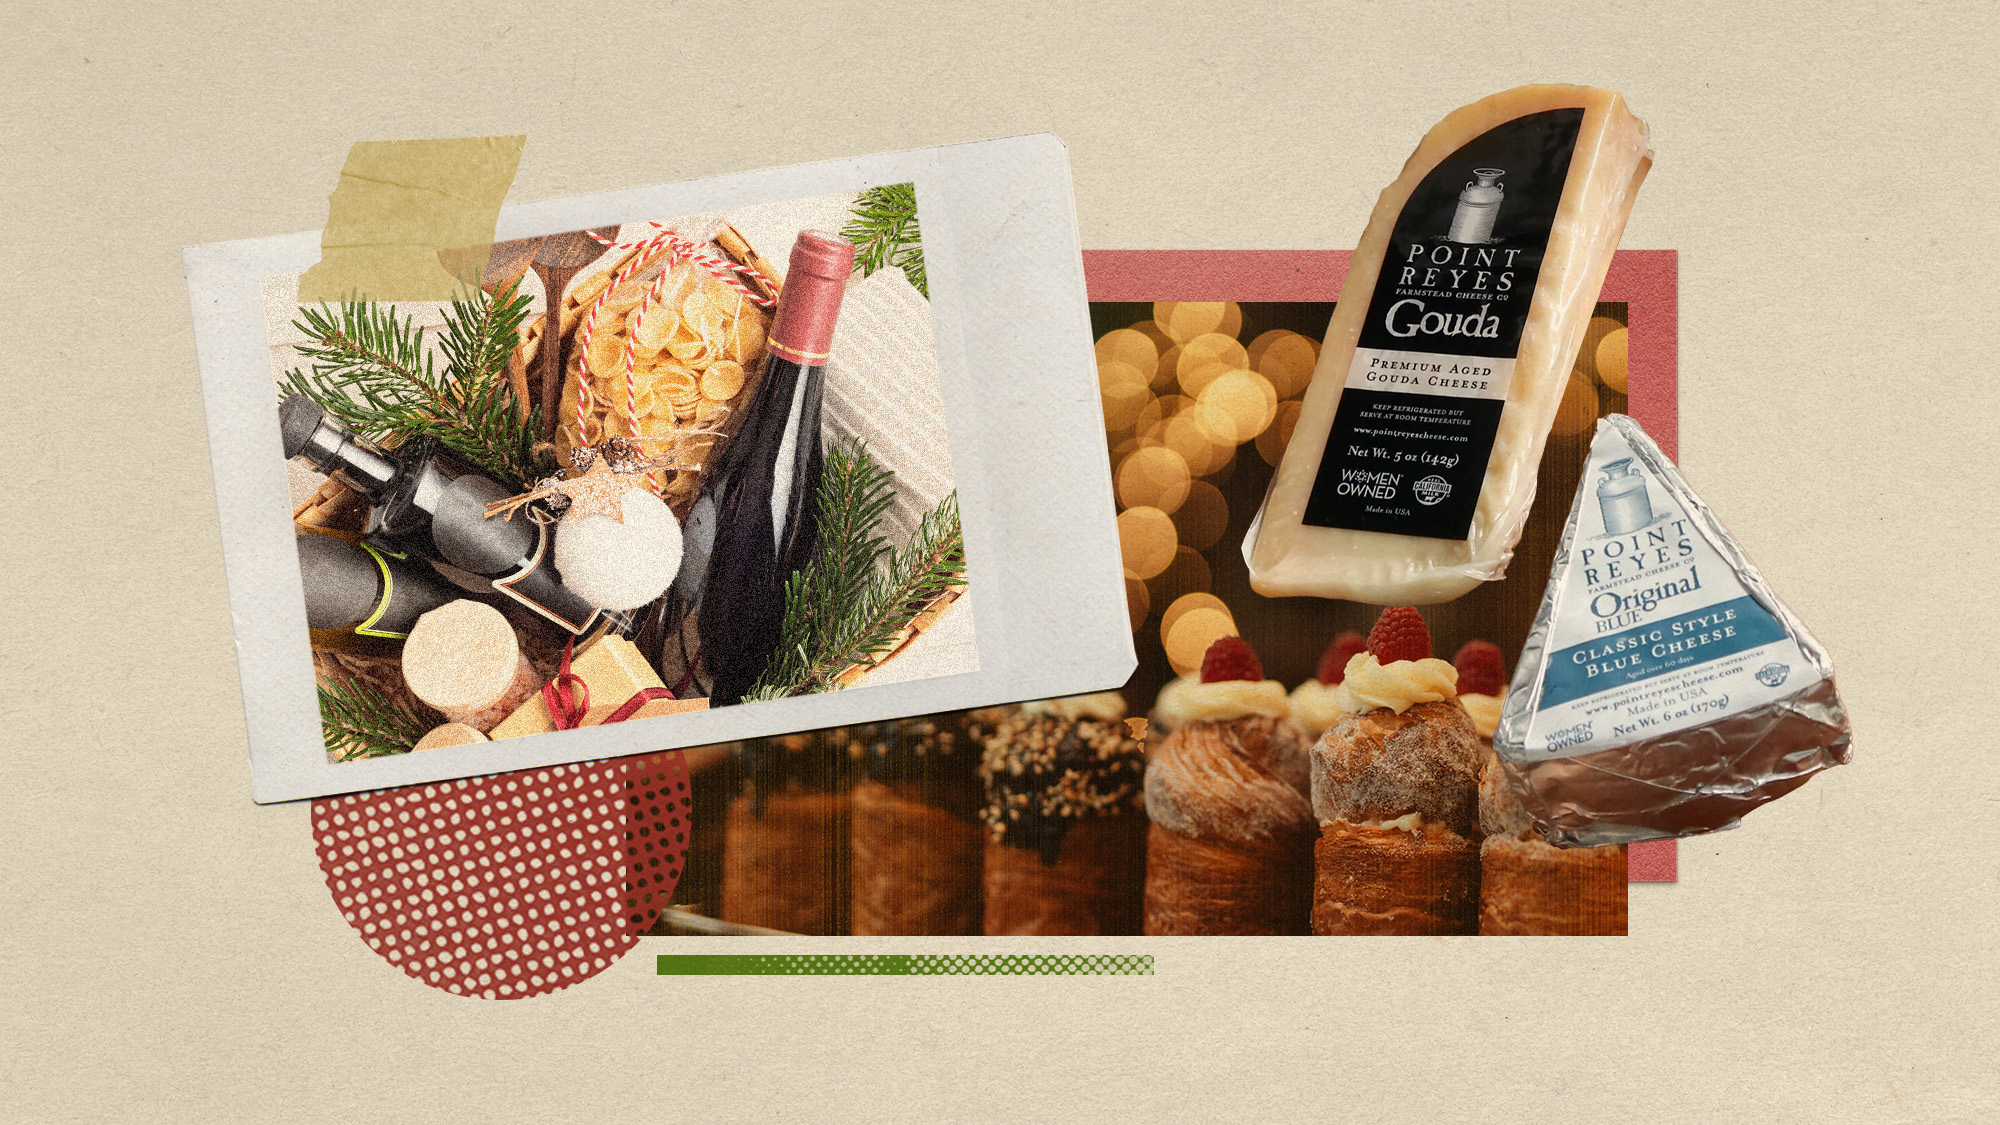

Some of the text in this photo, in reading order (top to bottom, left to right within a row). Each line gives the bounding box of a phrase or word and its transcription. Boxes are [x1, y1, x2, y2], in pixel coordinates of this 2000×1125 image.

[1407, 244, 1521, 267] POINT
[1399, 267, 1515, 291] REYES
[1396, 288, 1452, 298] FARMSTEAD
[1385, 299, 1500, 338] Gouda
[1371, 358, 1492, 376] PREMIUM AGED
[1366, 372, 1488, 390] GOUDA CHEESE
[1393, 406, 1446, 415] REFRIGERATED
[1419, 417, 1471, 426] TEMPERATURE
[1354, 427, 1468, 442] www.pointreyescheese.com
[1347, 445, 1368, 457] Net
[1372, 447, 1390, 459] Wt.
[1394, 451, 1402, 462] 5
[1421, 451, 1459, 468] (142g)
[1337, 483, 1396, 499] OWNED
[1415, 482, 1450, 493] CALIFORNIA
[1581, 518, 1687, 566] POINT
[1584, 538, 1693, 586] REYES
[1588, 574, 1642, 594] FARMSTEAD
[1645, 562, 1680, 576] CHEESE
[1590, 565, 1702, 618] Original
[1595, 609, 1642, 633] BLUE
[1573, 609, 1737, 664] CLASSIC STYLE
[1585, 626, 1736, 678] BLUE CHEESE
[1626, 669, 1645, 680] Aged
[1647, 665, 1663, 674] over
[1678, 656, 1694, 666] days
[1571, 701, 1588, 710] KEEP
[1592, 686, 1642, 704] REFRIGERATED
[1660, 675, 1680, 684] SERVE
[1694, 666, 1714, 674] ROOM
[1716, 651, 1764, 668] TEMPERATURE
[1585, 667, 1744, 715] www.pointreyescheese.com
[1628, 688, 1708, 716] Made in USA
[1613, 694, 1729, 738] Net Wt. 6 oz (170g)
[1547, 731, 1593, 752] OWNED
